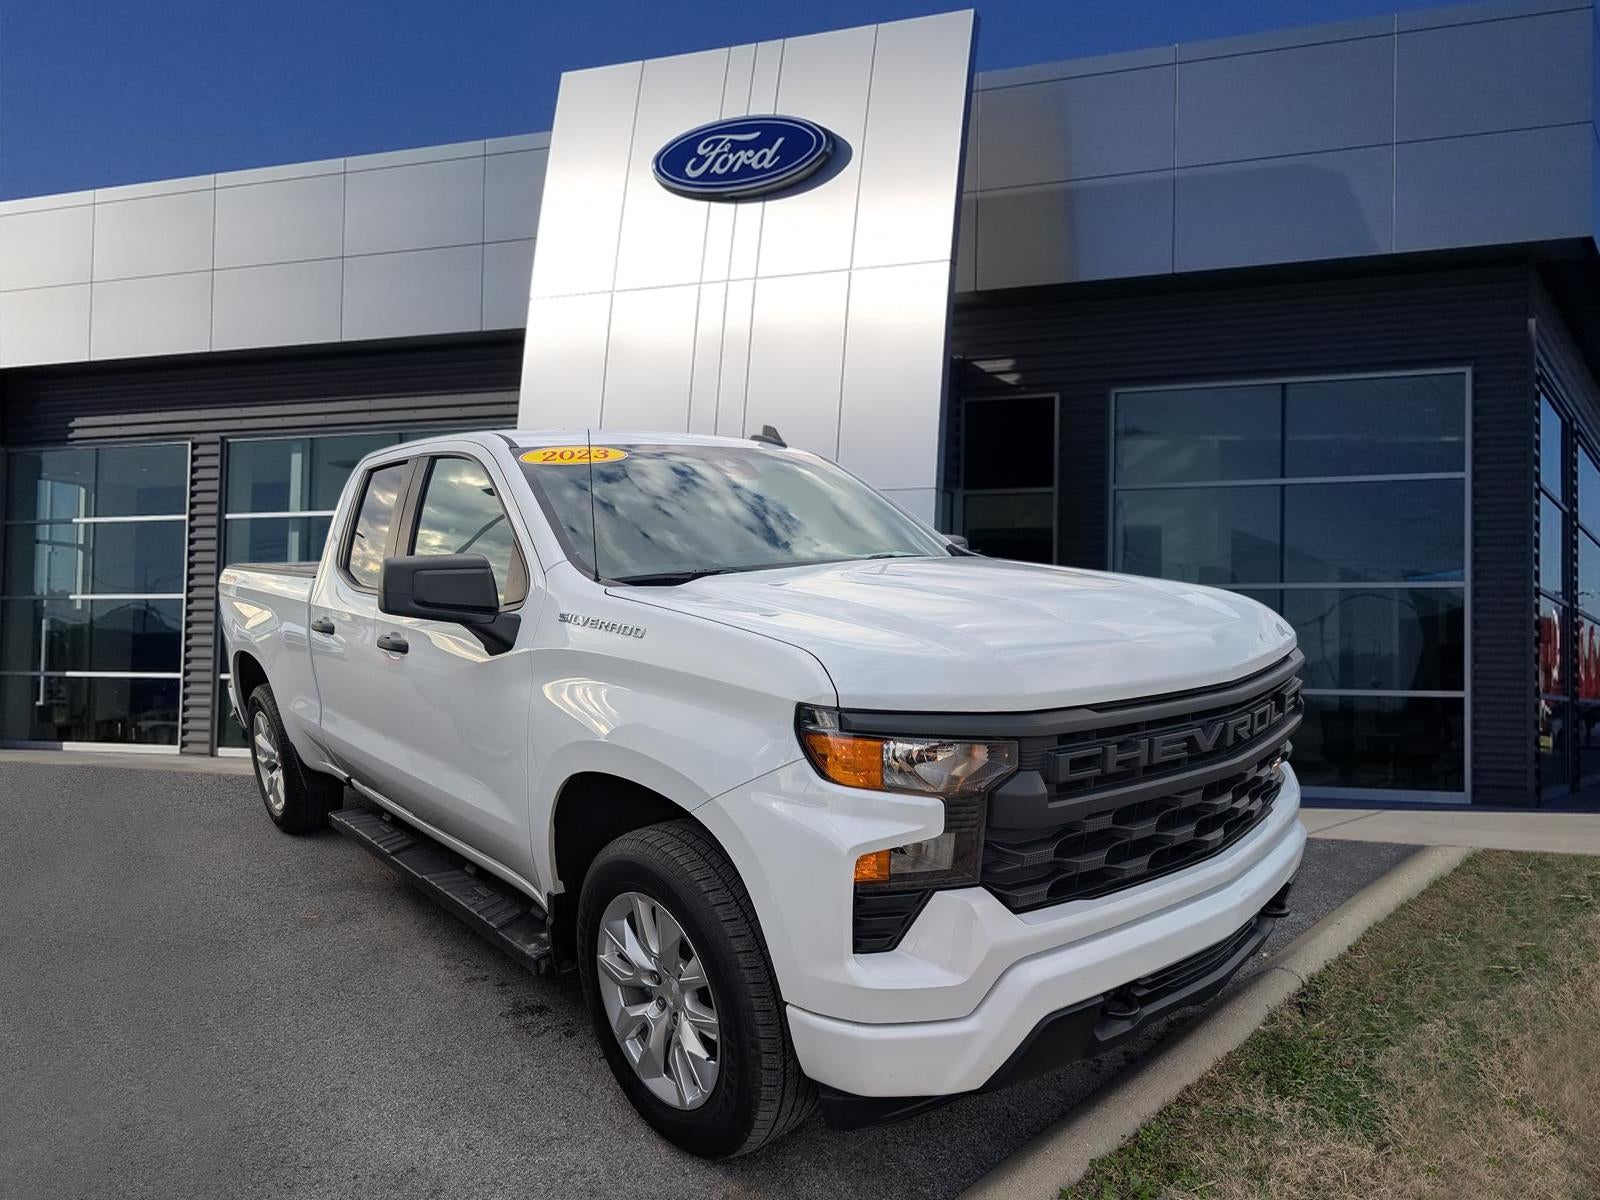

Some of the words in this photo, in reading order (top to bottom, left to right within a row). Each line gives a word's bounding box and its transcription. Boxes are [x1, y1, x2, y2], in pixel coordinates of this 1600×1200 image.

[685, 131, 785, 178] Ford
[542, 449, 609, 462] 2023
[558, 612, 647, 639] SILVERADO
[1050, 678, 1303, 783] CHEVROLE
